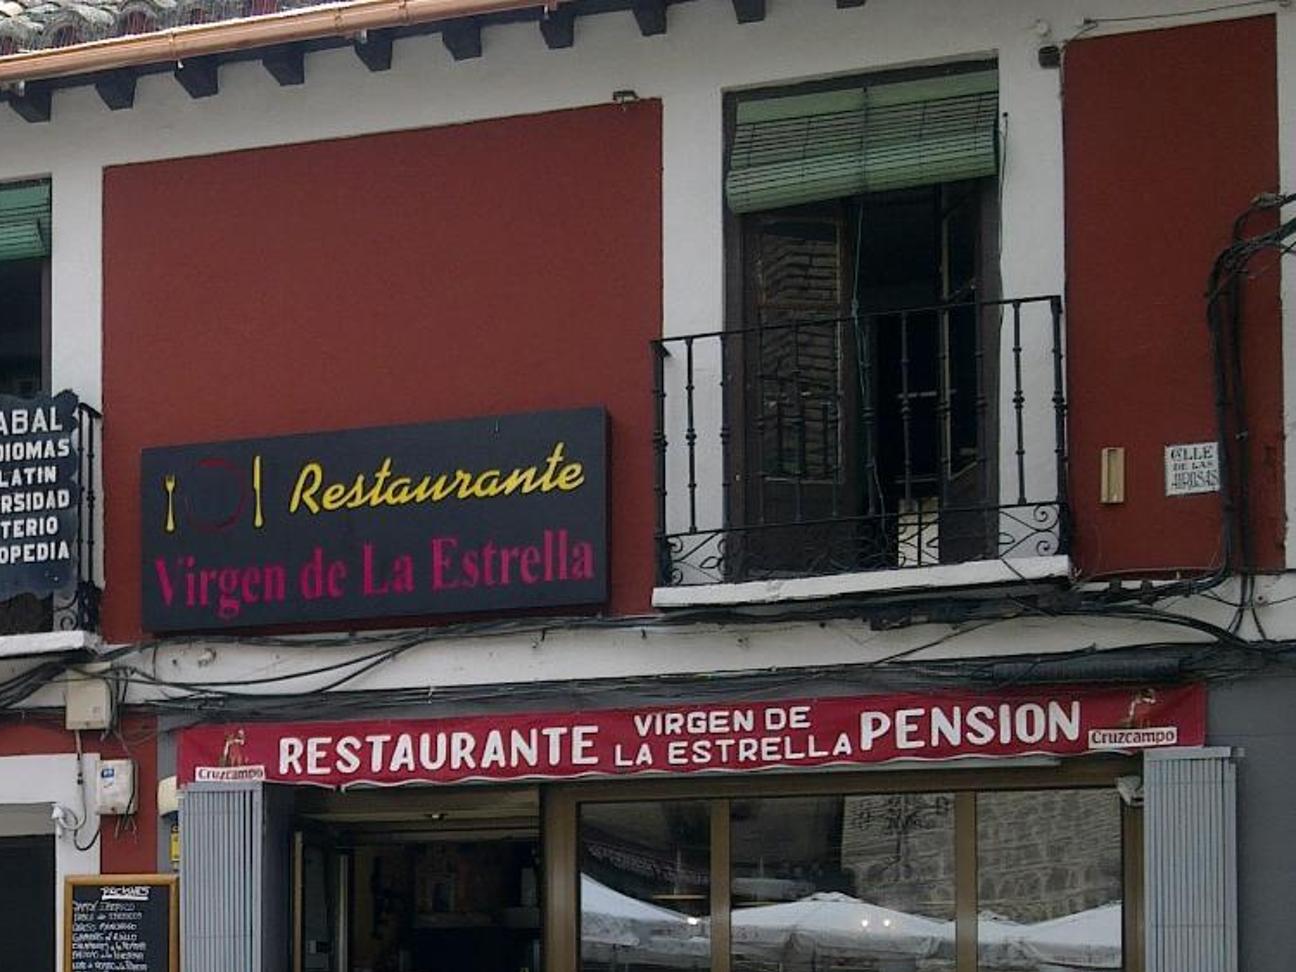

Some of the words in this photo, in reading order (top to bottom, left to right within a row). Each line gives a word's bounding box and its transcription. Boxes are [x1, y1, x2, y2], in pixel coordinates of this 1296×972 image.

[290, 441, 585, 514] Restaurante
[156, 555, 286, 619] Virgen
[299, 547, 347, 599] de
[363, 543, 414, 597] La
[432, 529, 594, 591] Estrella
[634, 709, 755, 736] VIRGEN
[765, 706, 811, 731] DE
[860, 701, 1082, 751] PENSION
[1091, 730, 1175, 744] Cruzcampo
[279, 725, 600, 774] RESTAURANTE
[614, 742, 653, 767] LA
[667, 733, 852, 765] ESTRELLA
